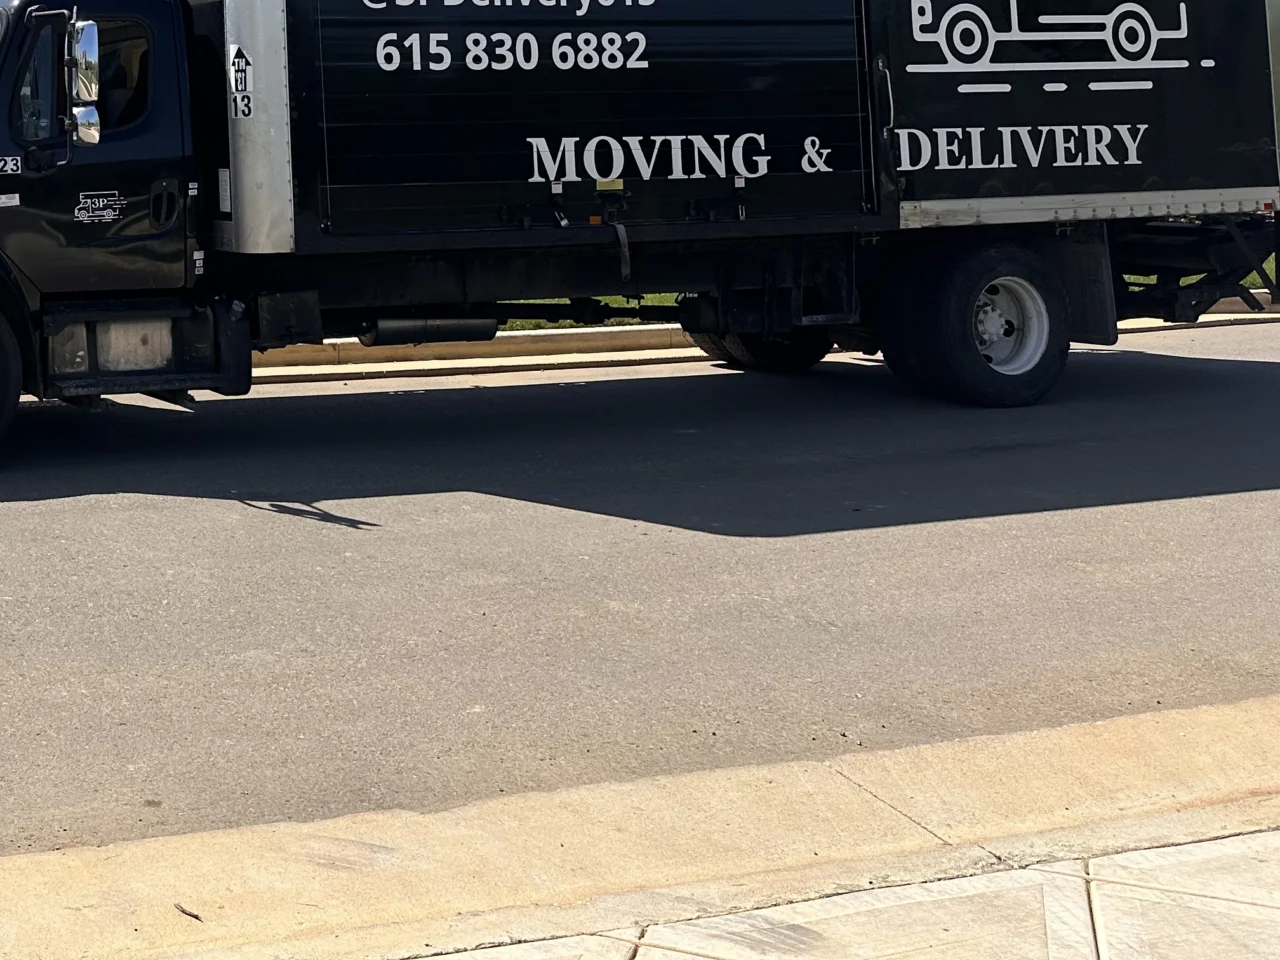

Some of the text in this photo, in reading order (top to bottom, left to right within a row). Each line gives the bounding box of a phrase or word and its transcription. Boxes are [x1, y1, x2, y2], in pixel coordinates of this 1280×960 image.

[376, 31, 649, 71] 615 830 6882
[232, 94, 252, 118] 13
[526, 124, 1149, 182] MOVING & DELIVERY
[91, 198, 107, 208] 3P
